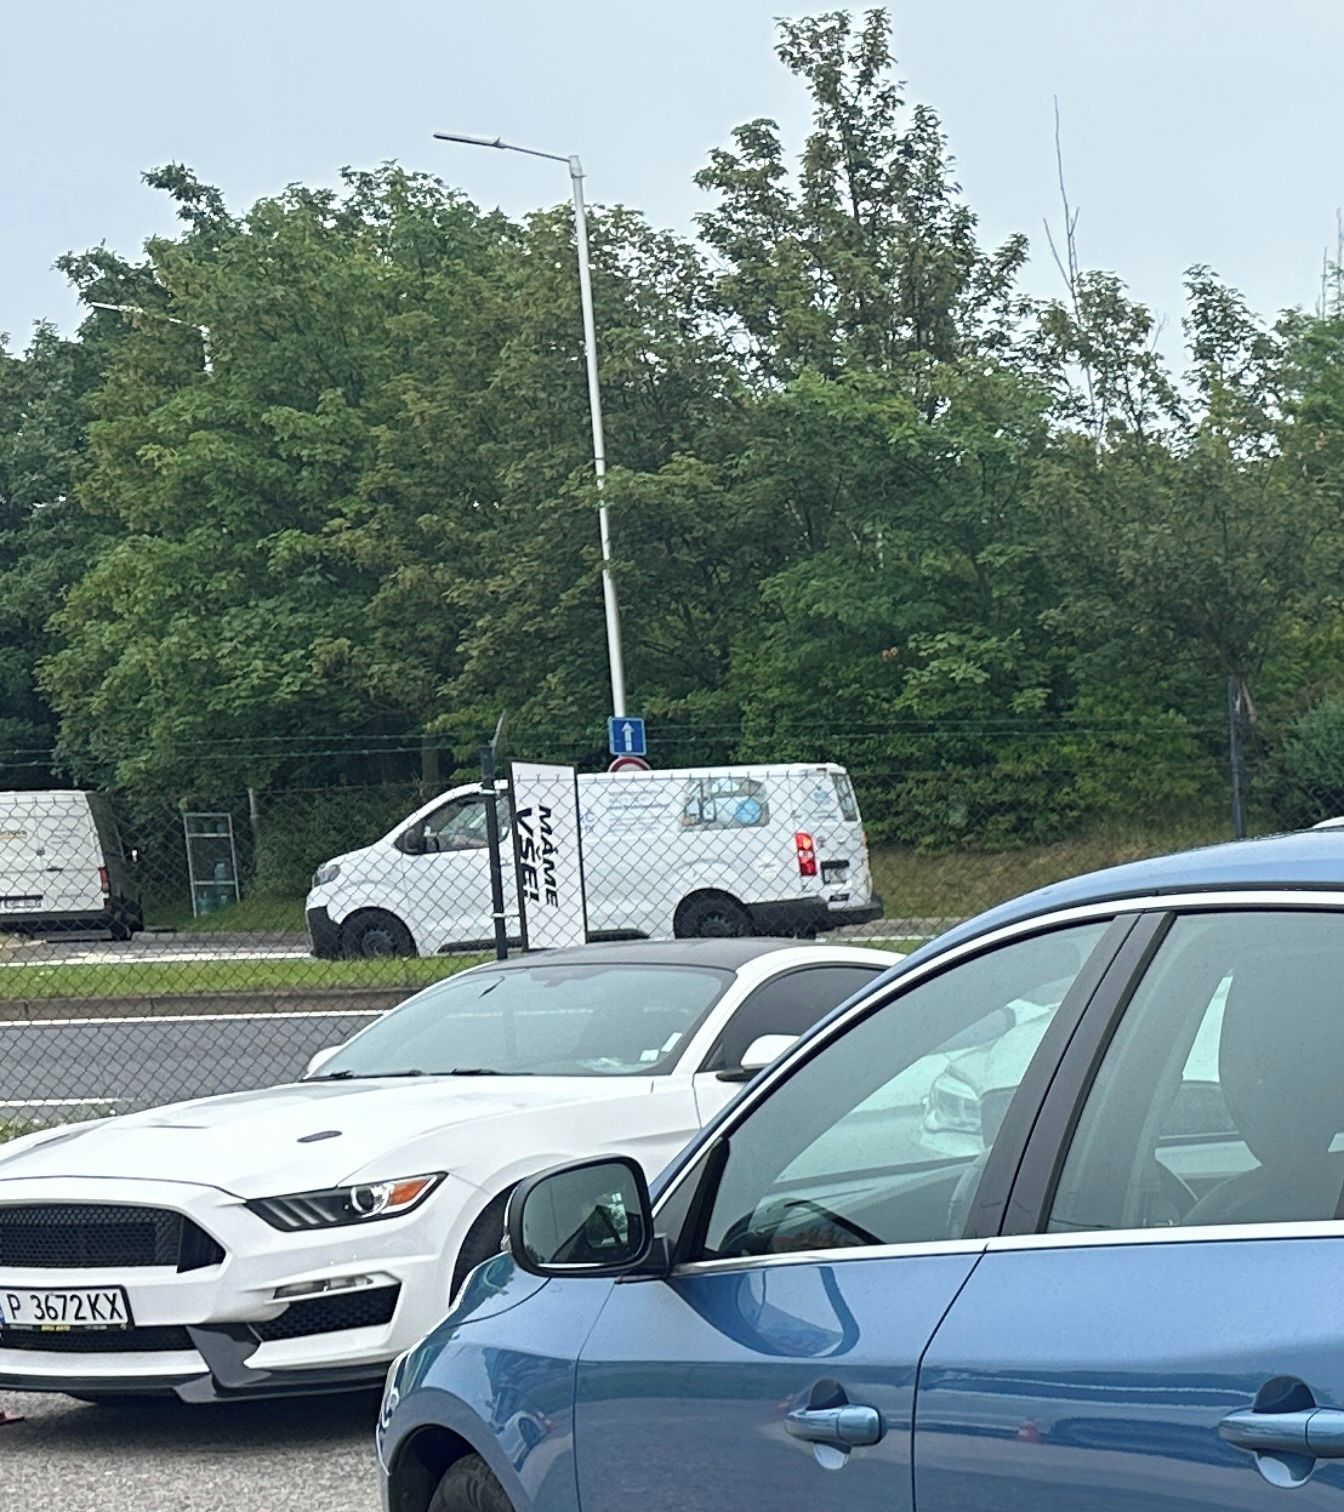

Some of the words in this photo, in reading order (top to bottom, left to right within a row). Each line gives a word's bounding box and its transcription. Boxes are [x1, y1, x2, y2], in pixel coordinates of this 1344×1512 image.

[538, 804, 559, 908] MÁME
[7, 1293, 21, 1320] P
[30, 1292, 123, 1320] 3672KX
